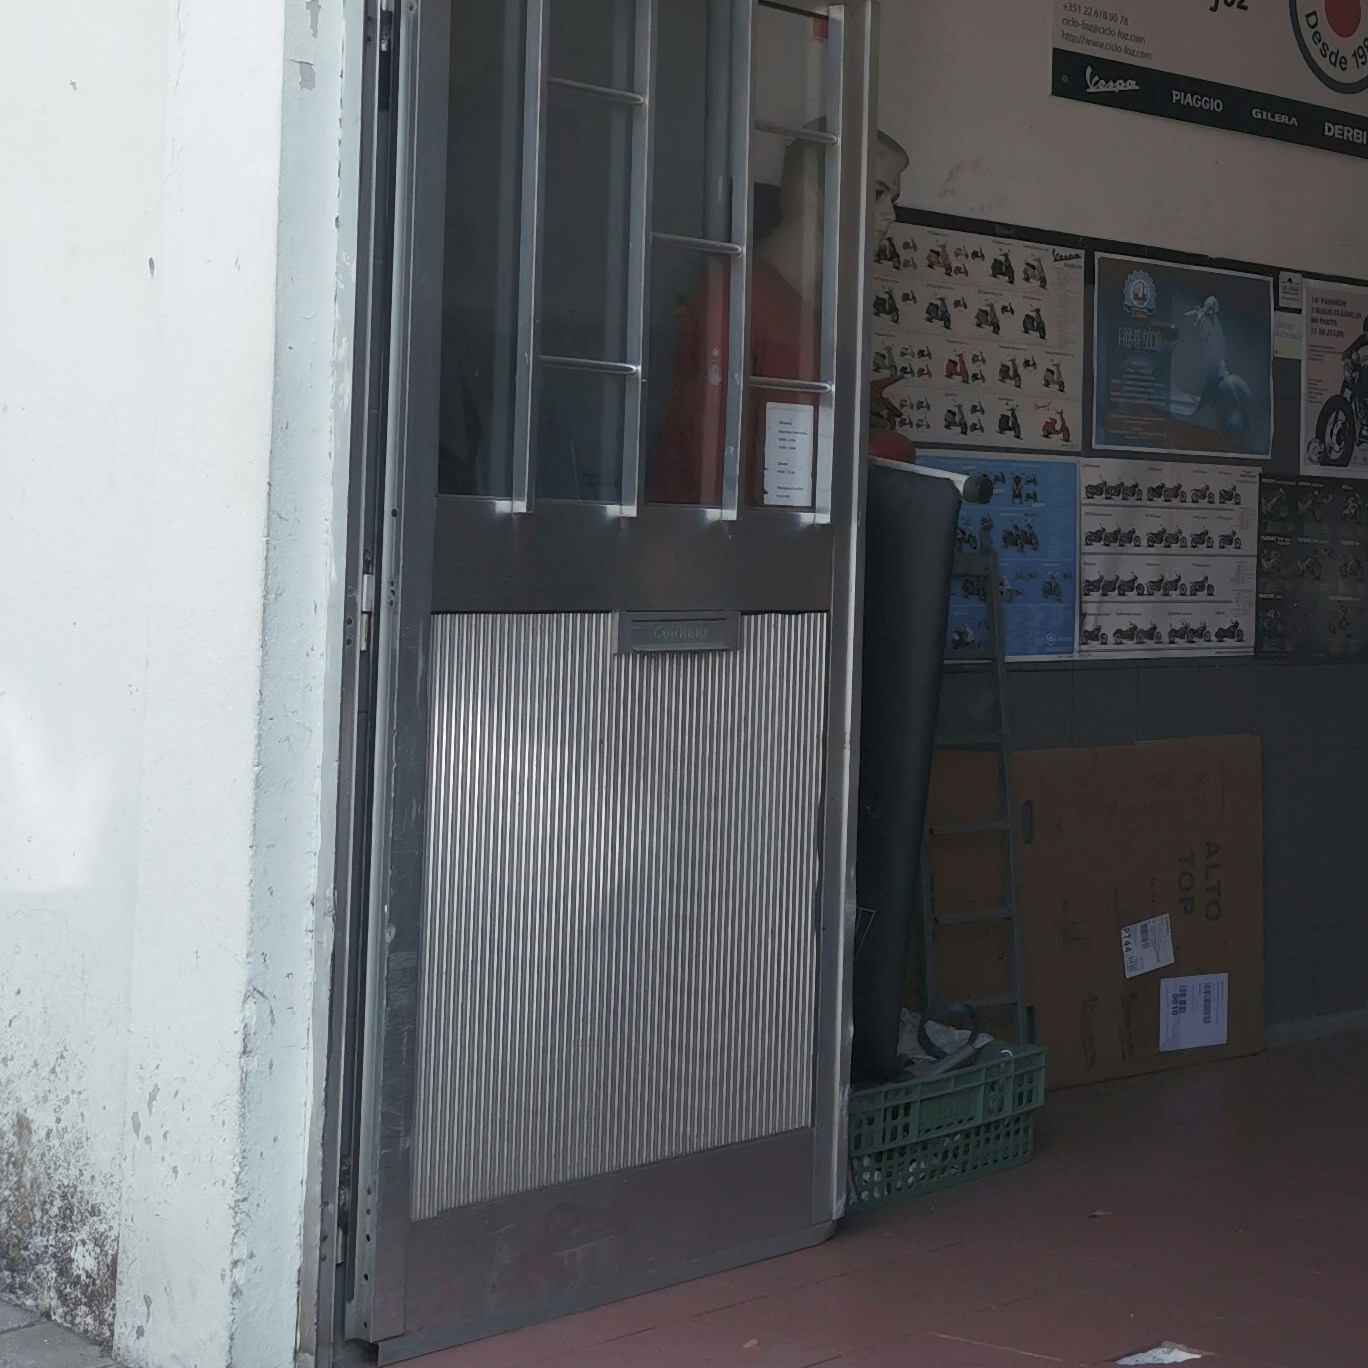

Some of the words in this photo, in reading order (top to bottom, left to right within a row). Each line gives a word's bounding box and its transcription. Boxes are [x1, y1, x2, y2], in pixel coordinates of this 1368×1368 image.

[1083, 4, 1093, 16] 22
[1093, 7, 1108, 21] 618
[1108, 12, 1119, 24] 90
[1119, 14, 1129, 26] 78
[1305, 10, 1348, 72] Desde
[1085, 64, 1141, 93] Vespa
[1171, 89, 1223, 113] PIAGGIO
[1251, 108, 1299, 127] GILERA
[1324, 121, 1368, 145] DERBI
[1178, 851, 1195, 914] TOP
[1205, 840, 1221, 922] ALTO
